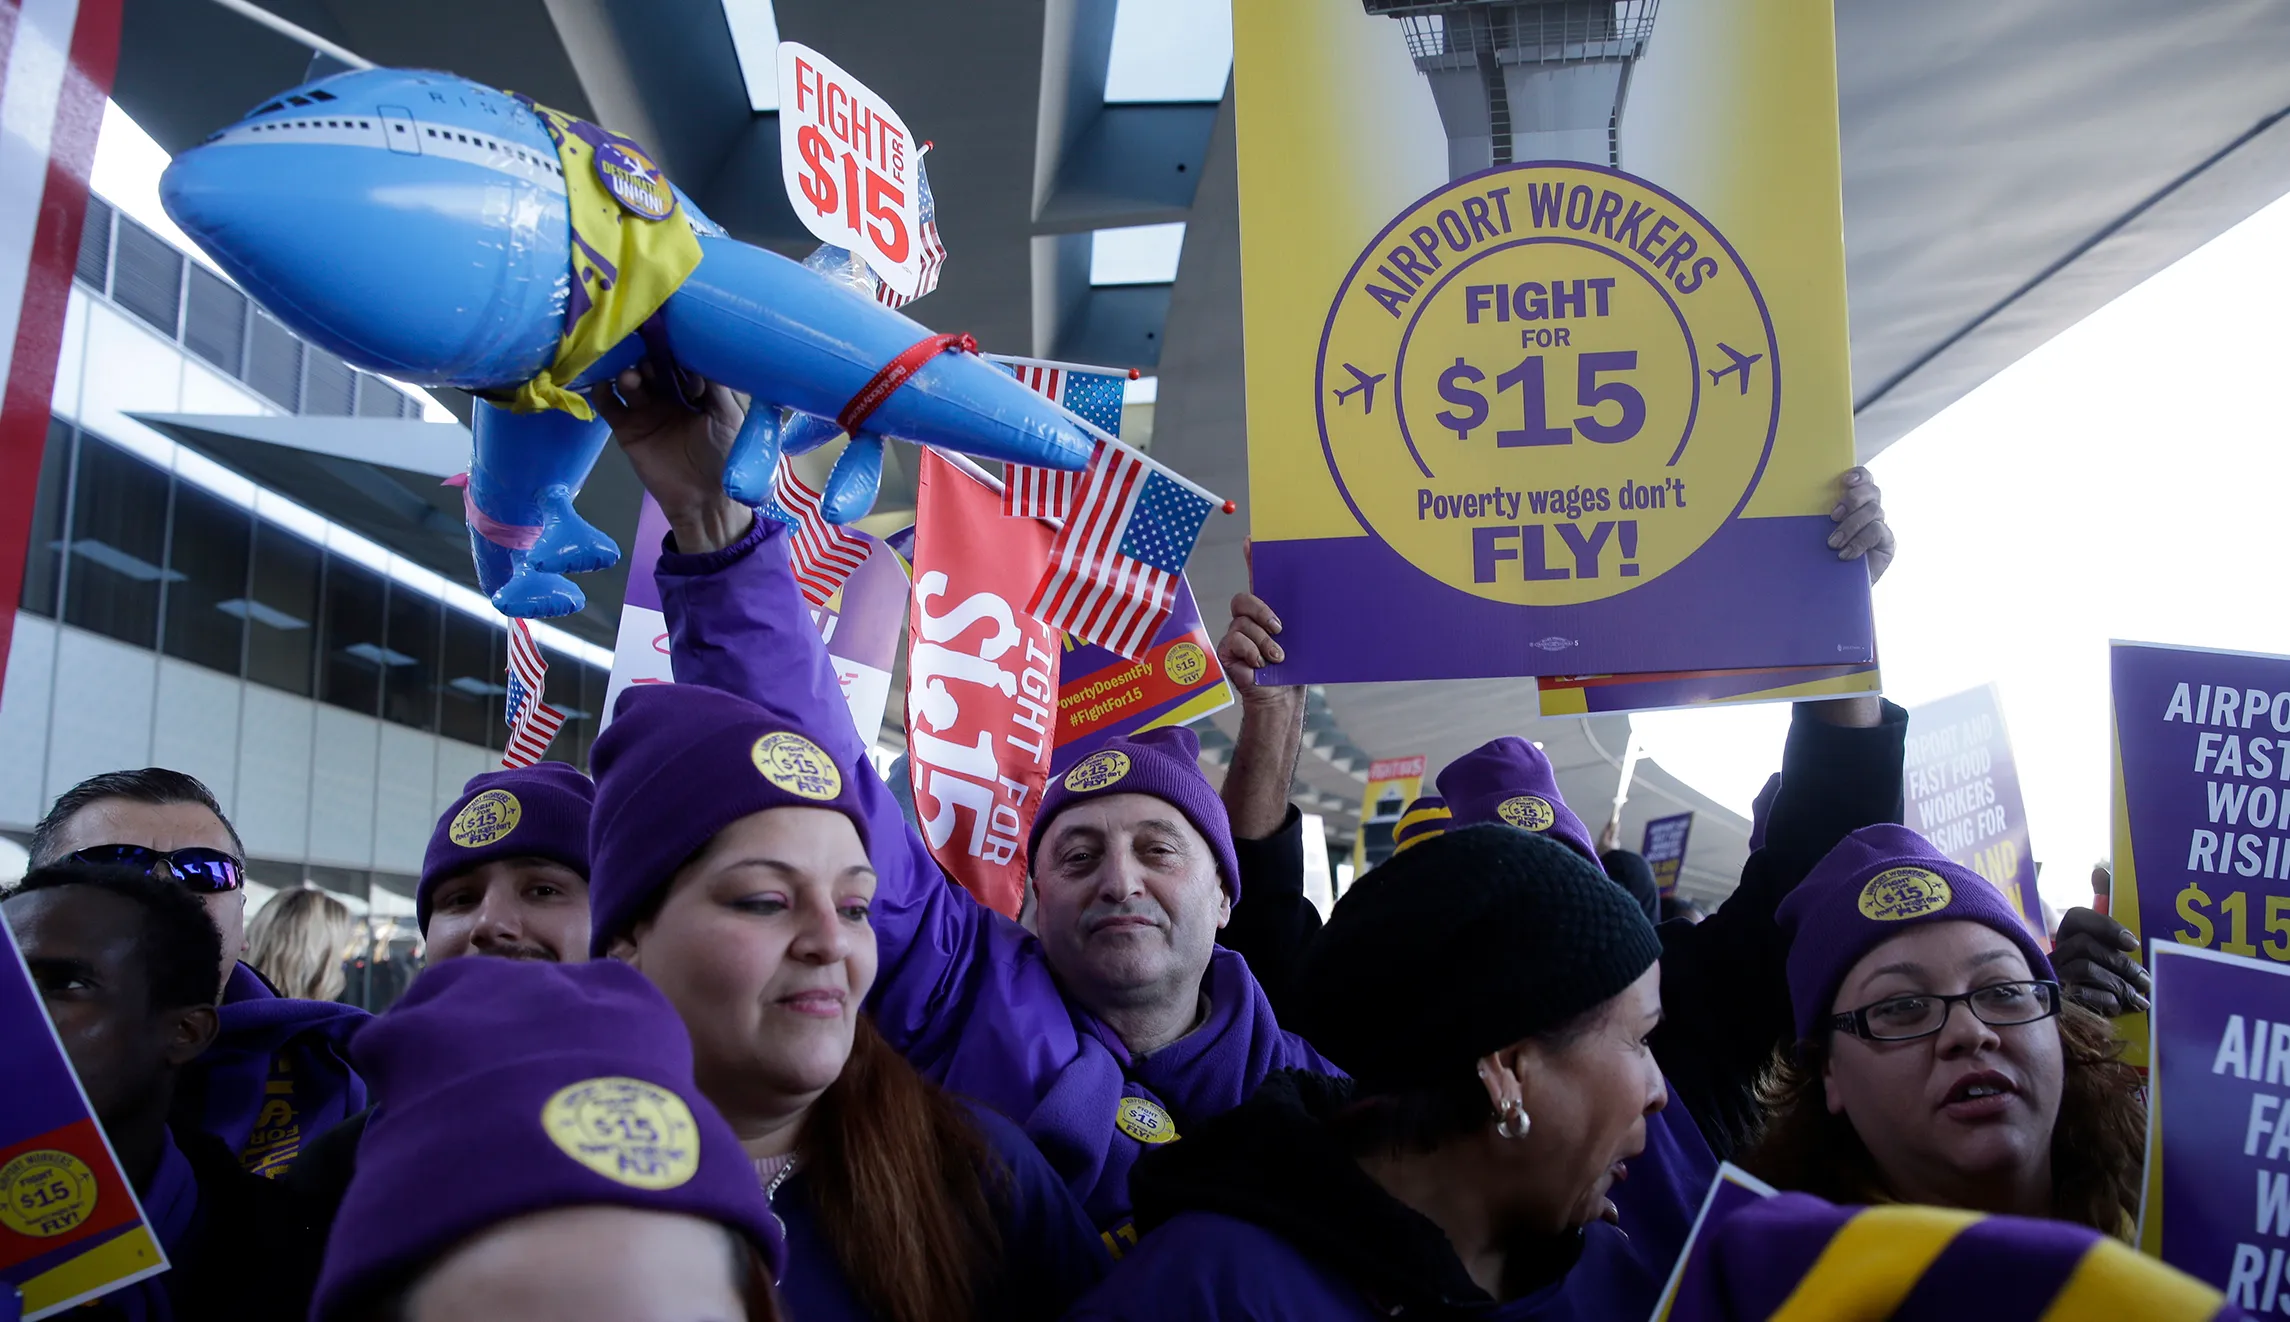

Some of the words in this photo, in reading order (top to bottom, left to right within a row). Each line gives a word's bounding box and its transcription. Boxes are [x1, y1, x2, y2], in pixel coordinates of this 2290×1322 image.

[795, 56, 904, 172] FIGHT
[892, 138, 905, 184] FOR
[613, 176, 663, 215] UNION!
[797, 124, 909, 263] $15
[1364, 186, 1512, 319] AIRPORT
[1528, 182, 1718, 294] WORKERS
[1466, 278, 1615, 324] FIGHT
[1521, 328, 1571, 349] FOR
[1436, 350, 1646, 448] $15
[1418, 486, 1521, 520] Poverty
[1527, 485, 1610, 519] wages
[1619, 477, 1686, 510] don't
[1472, 520, 1640, 584] FLY!
[1176, 658, 1196, 671] $15
[1070, 686, 1143, 727] #FightFor15
[1962, 713, 1993, 748] AND
[1909, 761, 1949, 800] FAST
[1952, 746, 1992, 785] FOOD
[467, 812, 497, 829] $15
[473, 802, 495, 812] FIGHT
[982, 774, 1028, 866] FOR
[1918, 777, 1995, 830] WORKERS
[1977, 804, 2007, 837] FOR
[469, 832, 496, 845] FLY!
[1882, 877, 1909, 888] FIGHT
[1974, 839, 2019, 888] AND
[1883, 887, 1923, 903] $15
[2174, 881, 2290, 961] $15
[1129, 1109, 1158, 1129] $15
[1137, 1105, 1158, 1118] FIGHT
[1126, 1125, 1150, 1140] FLY!
[20, 1180, 70, 1209] $15
[40, 1212, 81, 1234] FLY!
